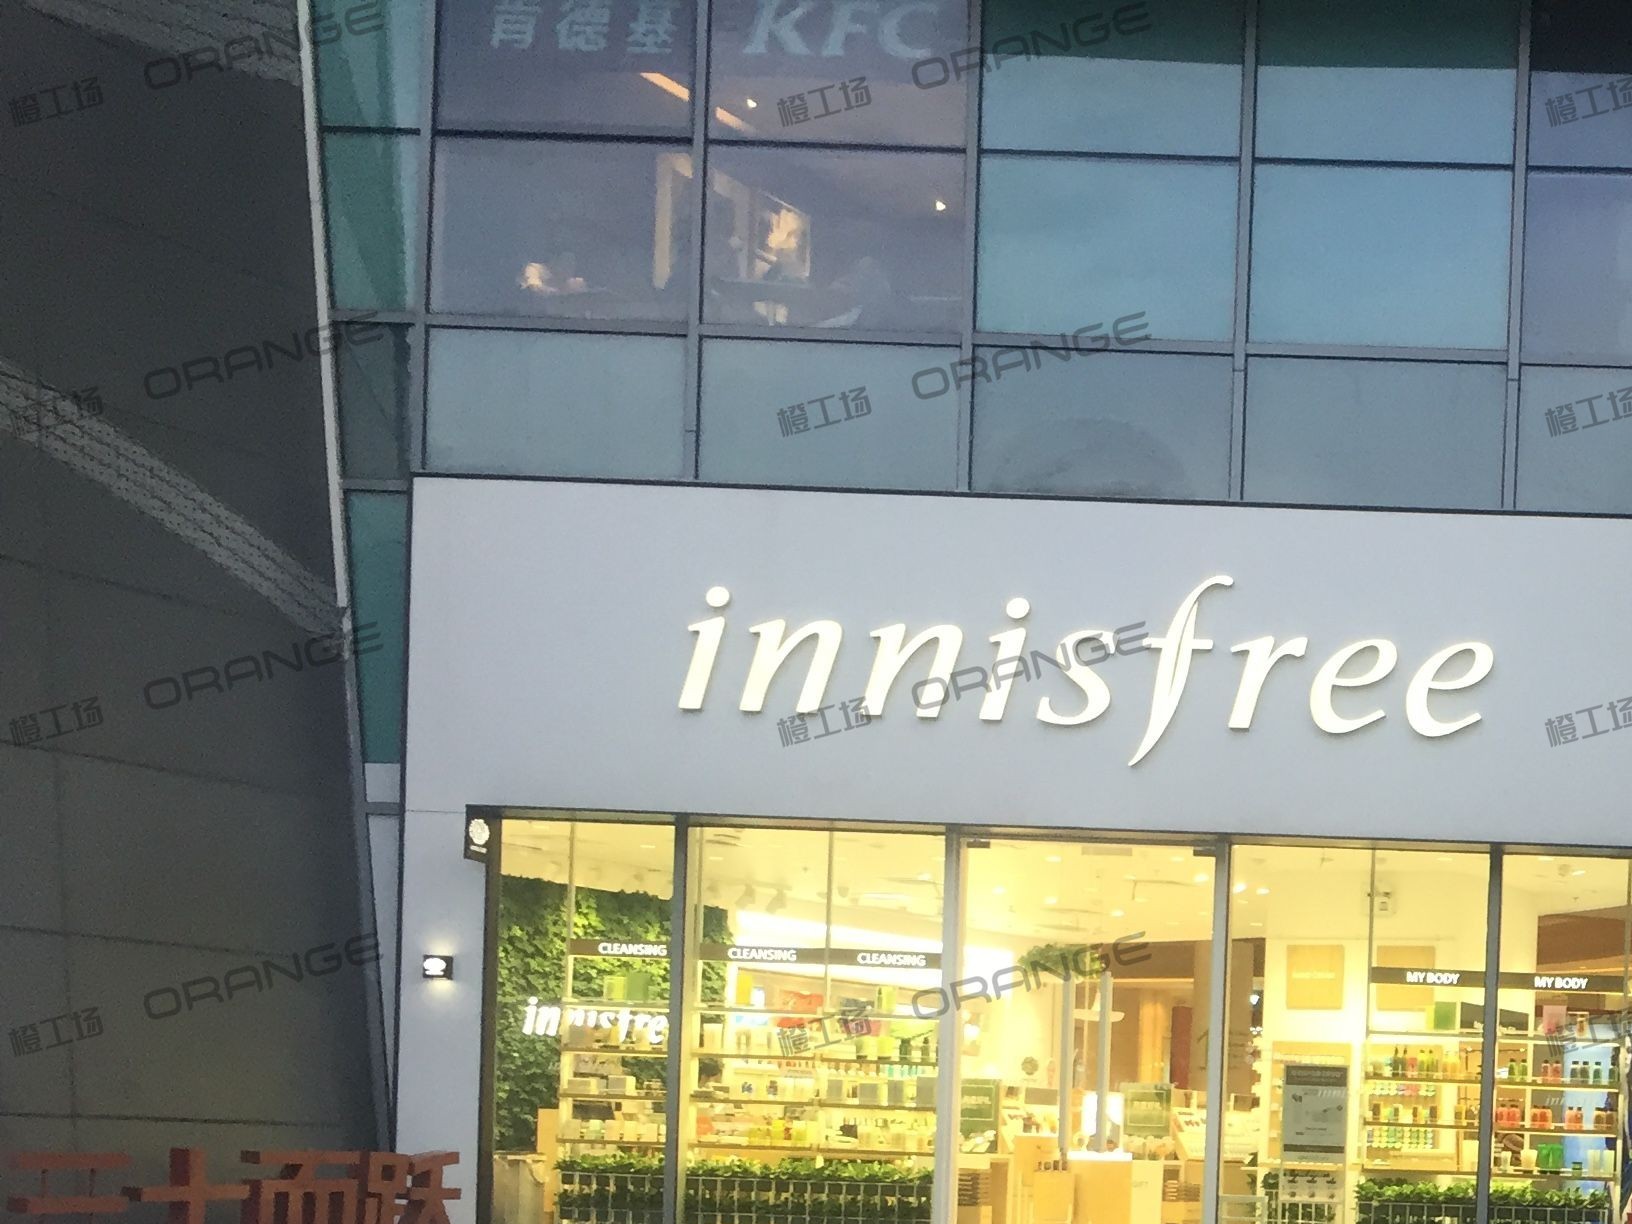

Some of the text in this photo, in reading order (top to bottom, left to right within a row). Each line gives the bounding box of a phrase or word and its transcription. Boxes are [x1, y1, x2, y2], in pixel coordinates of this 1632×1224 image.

[490, 0, 938, 57] 肯德基 KFC
[677, 574, 1494, 767] innisfree
[598, 942, 667, 956] CLEANSING
[728, 947, 797, 962] CLEANSING
[856, 951, 926, 967] CLEANSING
[1406, 971, 1460, 985] MY BODY
[1534, 976, 1588, 990] MY BODY
